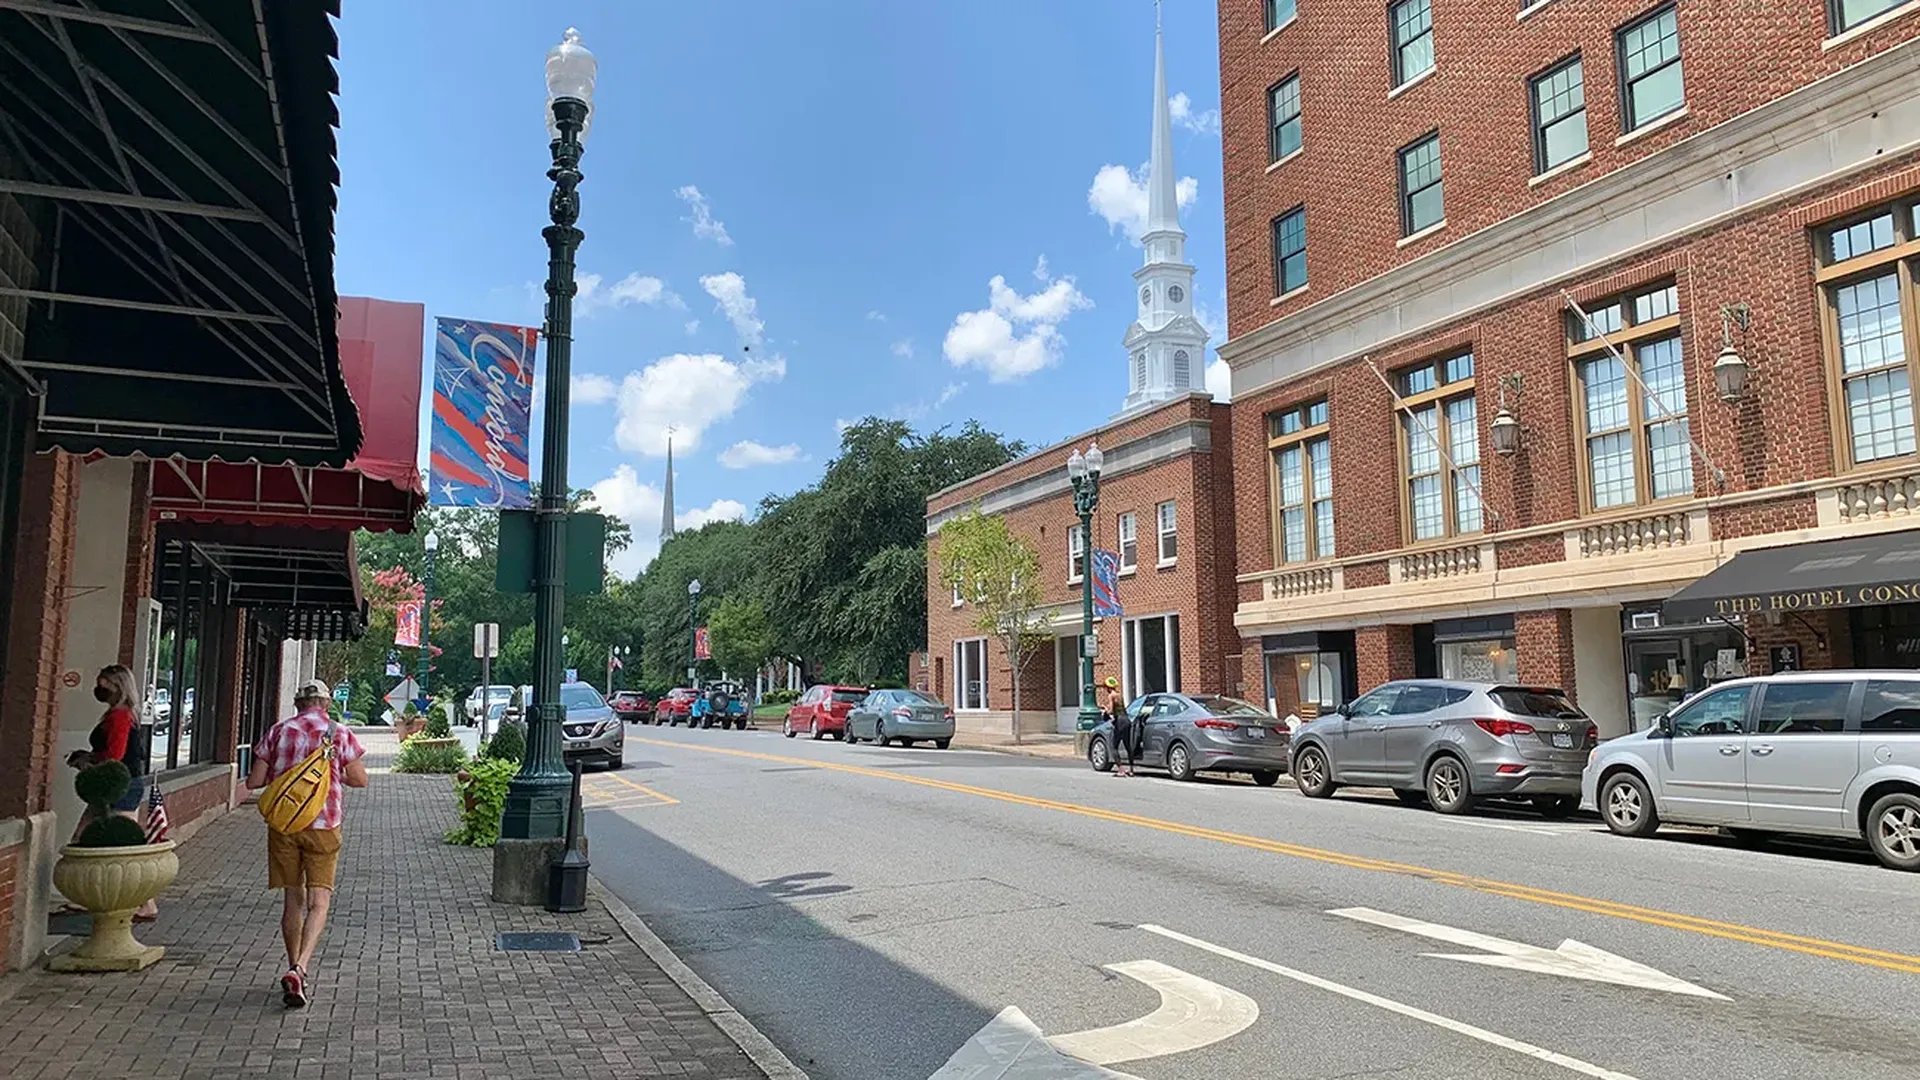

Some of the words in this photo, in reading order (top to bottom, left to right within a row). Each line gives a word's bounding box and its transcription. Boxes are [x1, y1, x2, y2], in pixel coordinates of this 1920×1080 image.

[469, 327, 528, 507] Concord
[1714, 595, 1762, 614] THE
[1770, 588, 1851, 610] HOTEL
